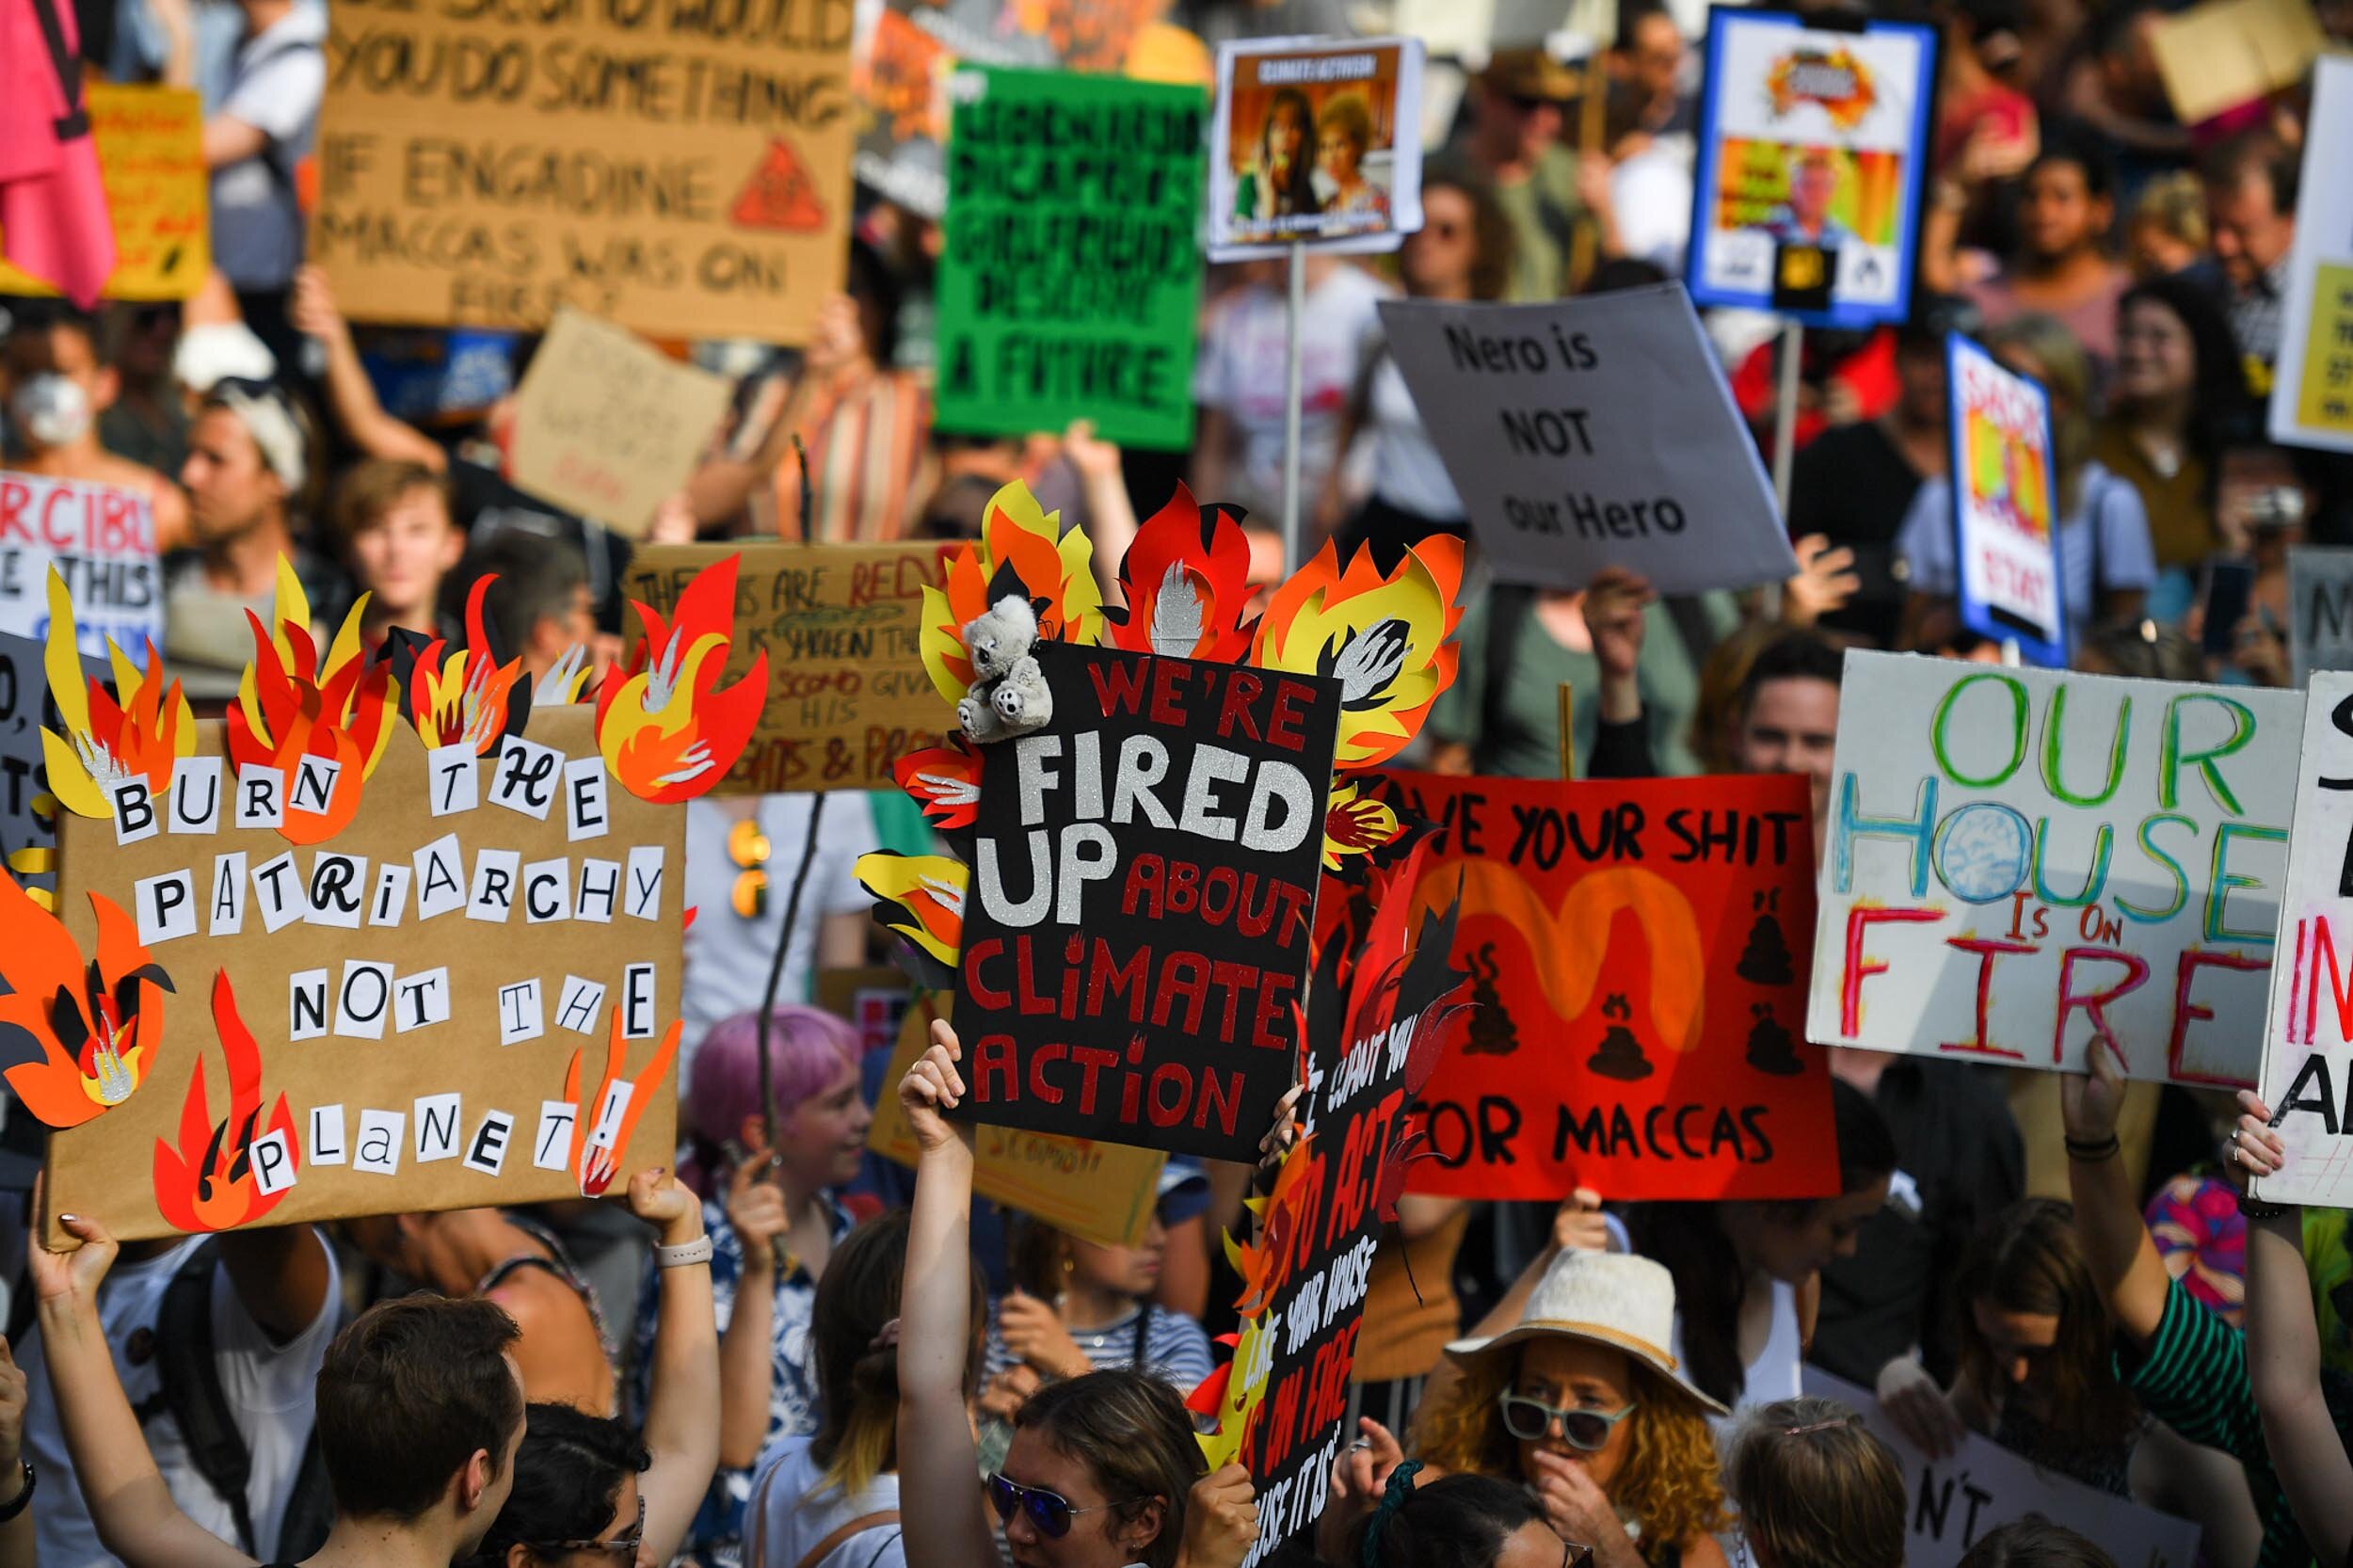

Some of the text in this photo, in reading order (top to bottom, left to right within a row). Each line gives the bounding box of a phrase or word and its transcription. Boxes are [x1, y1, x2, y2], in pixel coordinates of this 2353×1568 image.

[328, 29, 442, 95] YOU
[454, 37, 533, 103] DO
[535, 38, 845, 132] SOMETHING
[321, 135, 718, 223] IF ENGADINE
[312, 210, 787, 295] MACCAS WAS ON
[946, 332, 976, 397] A
[1444, 323, 1598, 374] Nero is
[1499, 410, 1594, 457] NOT
[1504, 492, 1687, 538] our Hero
[773, 566, 827, 610] ARE
[1087, 657, 1316, 752] WE'RE
[1930, 672, 2257, 817] OUR
[117, 744, 603, 835] BURN THE
[1016, 730, 1314, 852] FIRED
[1509, 801, 1646, 872] YOUR
[1665, 809, 1801, 867] SHIT
[1833, 772, 2288, 945] HOUSE
[976, 823, 1311, 948] UP ABOUT
[295, 966, 650, 1035] NOT THE
[1840, 905, 2271, 1090] FIRE
[1328, 1029, 1386, 1113] WANT
[1385, 1014, 1418, 1081] YOU
[1325, 1088, 1404, 1250] ACT
[1554, 1101, 1774, 1163] MACCAS
[1243, 1234, 1377, 1392] LIKE YOUR HOUSE
[1264, 1366, 1305, 1478] ON
[1300, 1316, 1363, 1446] FIRE
[1288, 1452, 1317, 1537] IT
